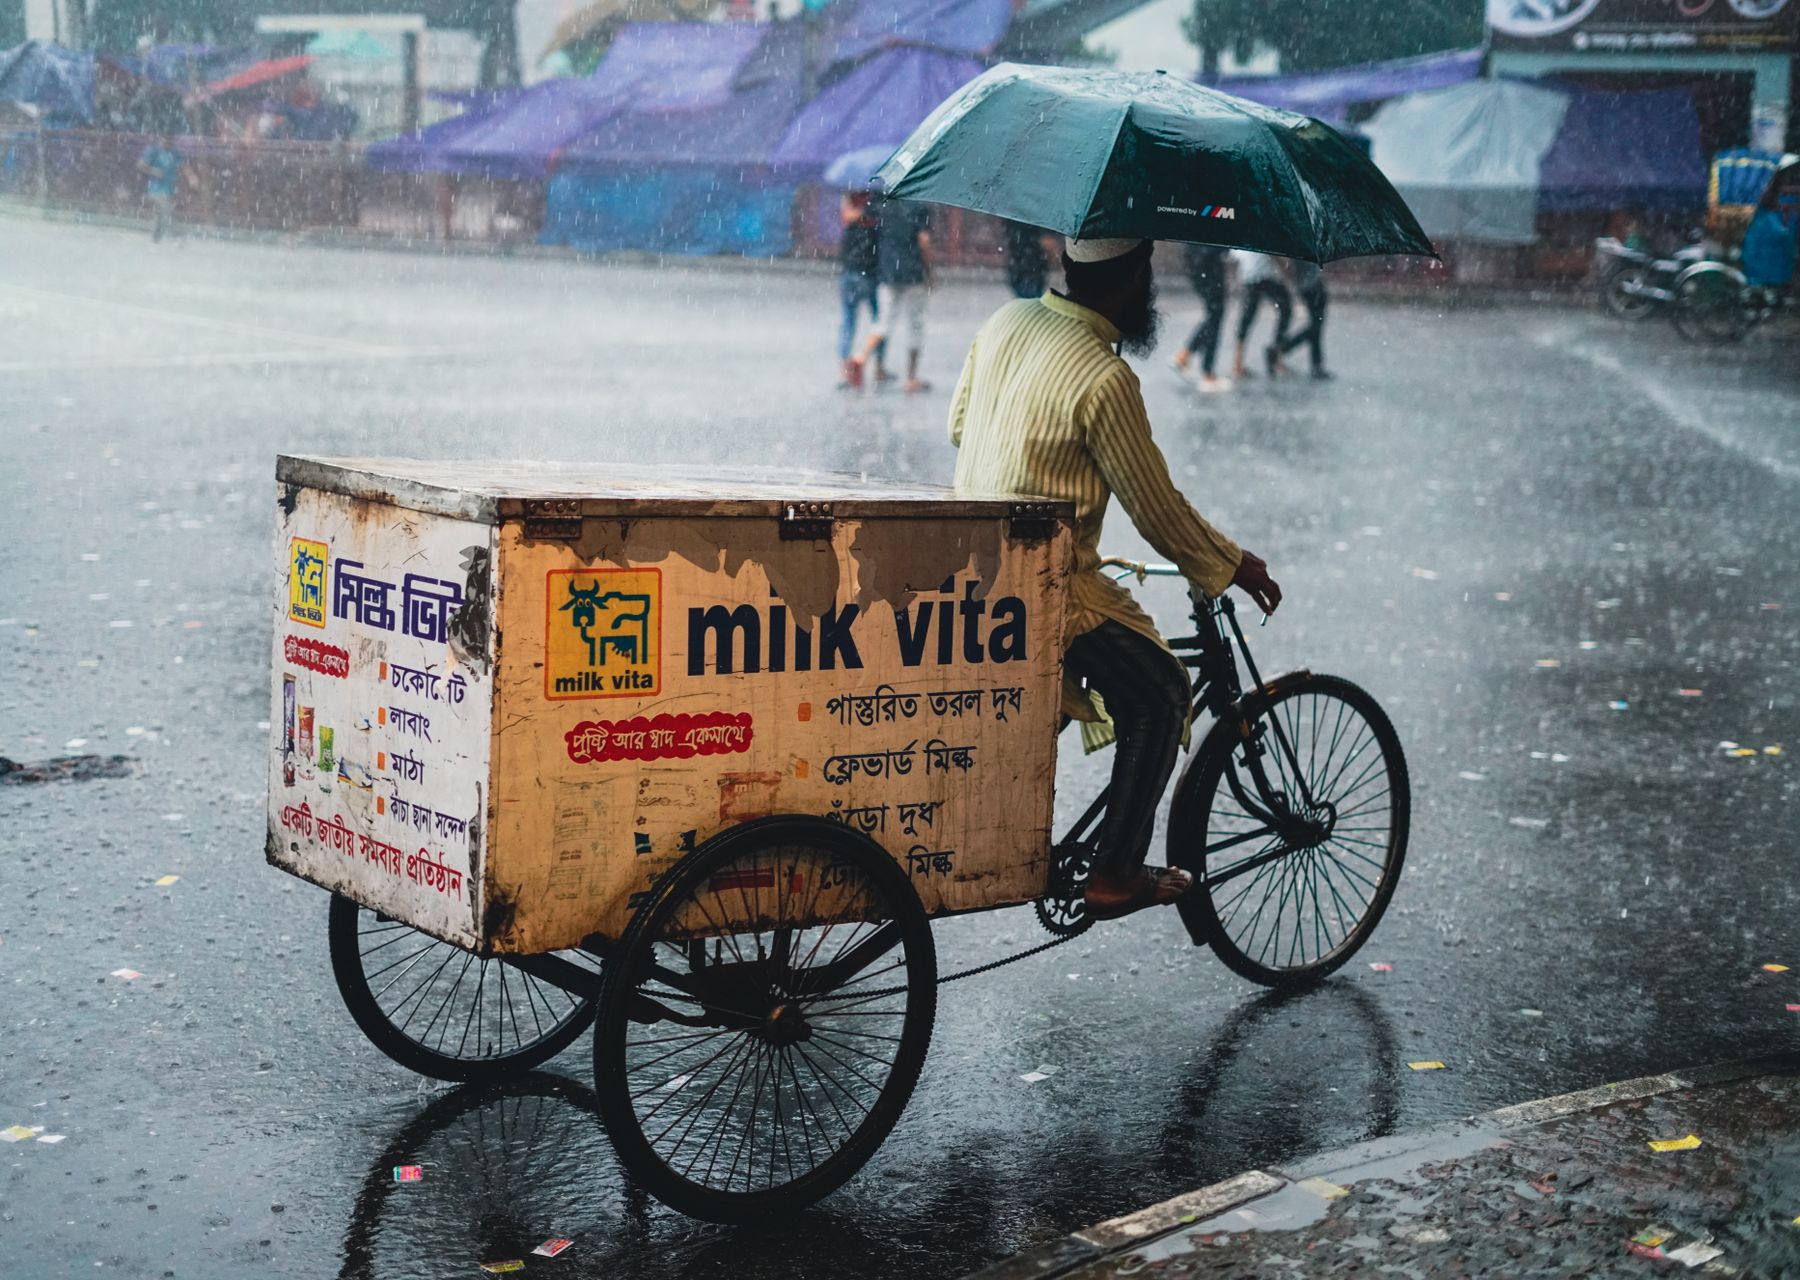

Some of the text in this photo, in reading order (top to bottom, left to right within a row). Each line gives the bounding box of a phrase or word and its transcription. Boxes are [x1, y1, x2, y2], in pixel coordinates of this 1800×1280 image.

[1157, 205, 1187, 214] powered
[1188, 206, 1197, 216] by
[333, 557, 396, 632] মিল্ক
[894, 574, 1027, 667] vita
[555, 669, 653, 693] milk vita
[826, 684, 1025, 726] পাস্তুরিত তরল দুধ
[389, 706, 432, 743] লাবাং
[572, 724, 745, 758] পুষ্টি আর স্বাদ একসাথে
[390, 749, 424, 785] মাঠা
[922, 738, 978, 776] মিল্ক
[412, 803, 432, 834] ছানা
[897, 801, 945, 836] দুধ
[280, 800, 463, 902] একটি জাতীয় সমবায় প্রতিষ্ঠান
[907, 845, 955, 882] মিল্ক
